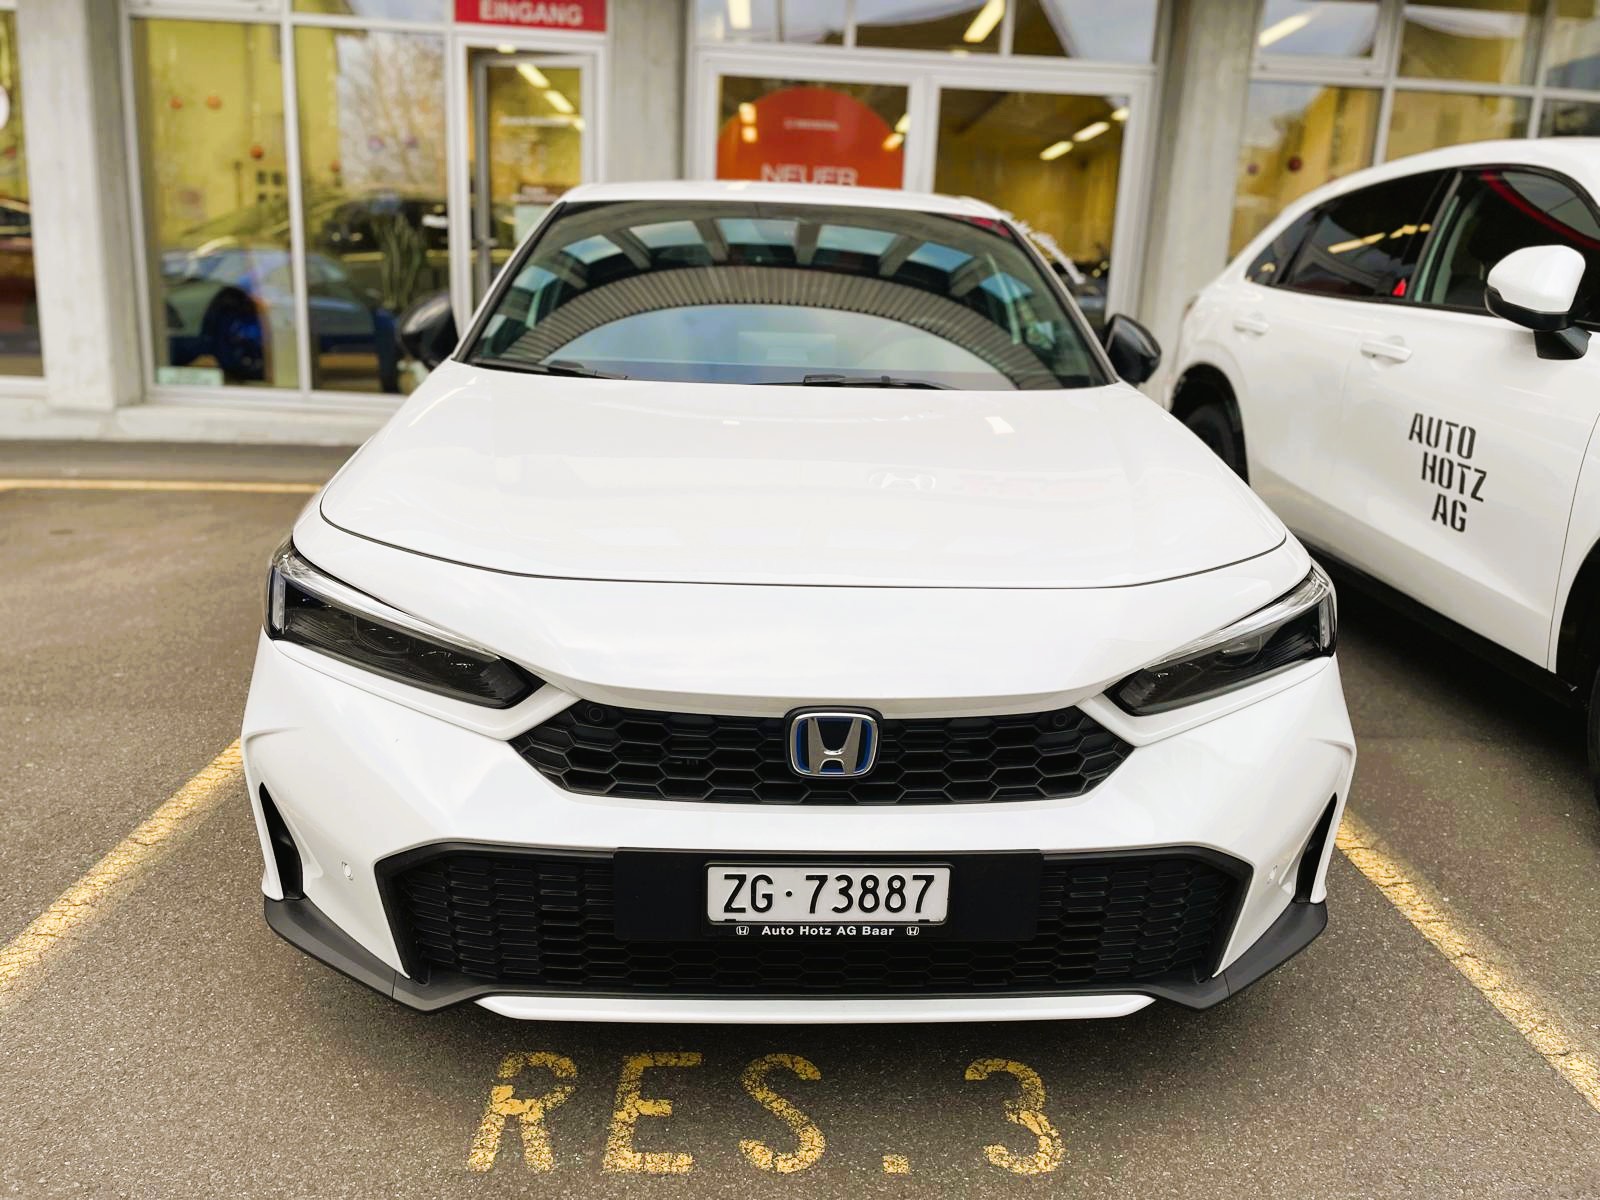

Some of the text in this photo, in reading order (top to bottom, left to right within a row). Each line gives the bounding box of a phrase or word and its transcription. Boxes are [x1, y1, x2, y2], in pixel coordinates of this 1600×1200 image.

[479, 0, 584, 26] EINGANG
[1408, 413, 1476, 460] AUTO
[1421, 451, 1487, 503] HOTZ
[1431, 493, 1468, 533] AG
[805, 874, 935, 914] 73887
[761, 925, 895, 936] Auto Hotz AG Baar
[963, 1058, 1066, 1176] 3
